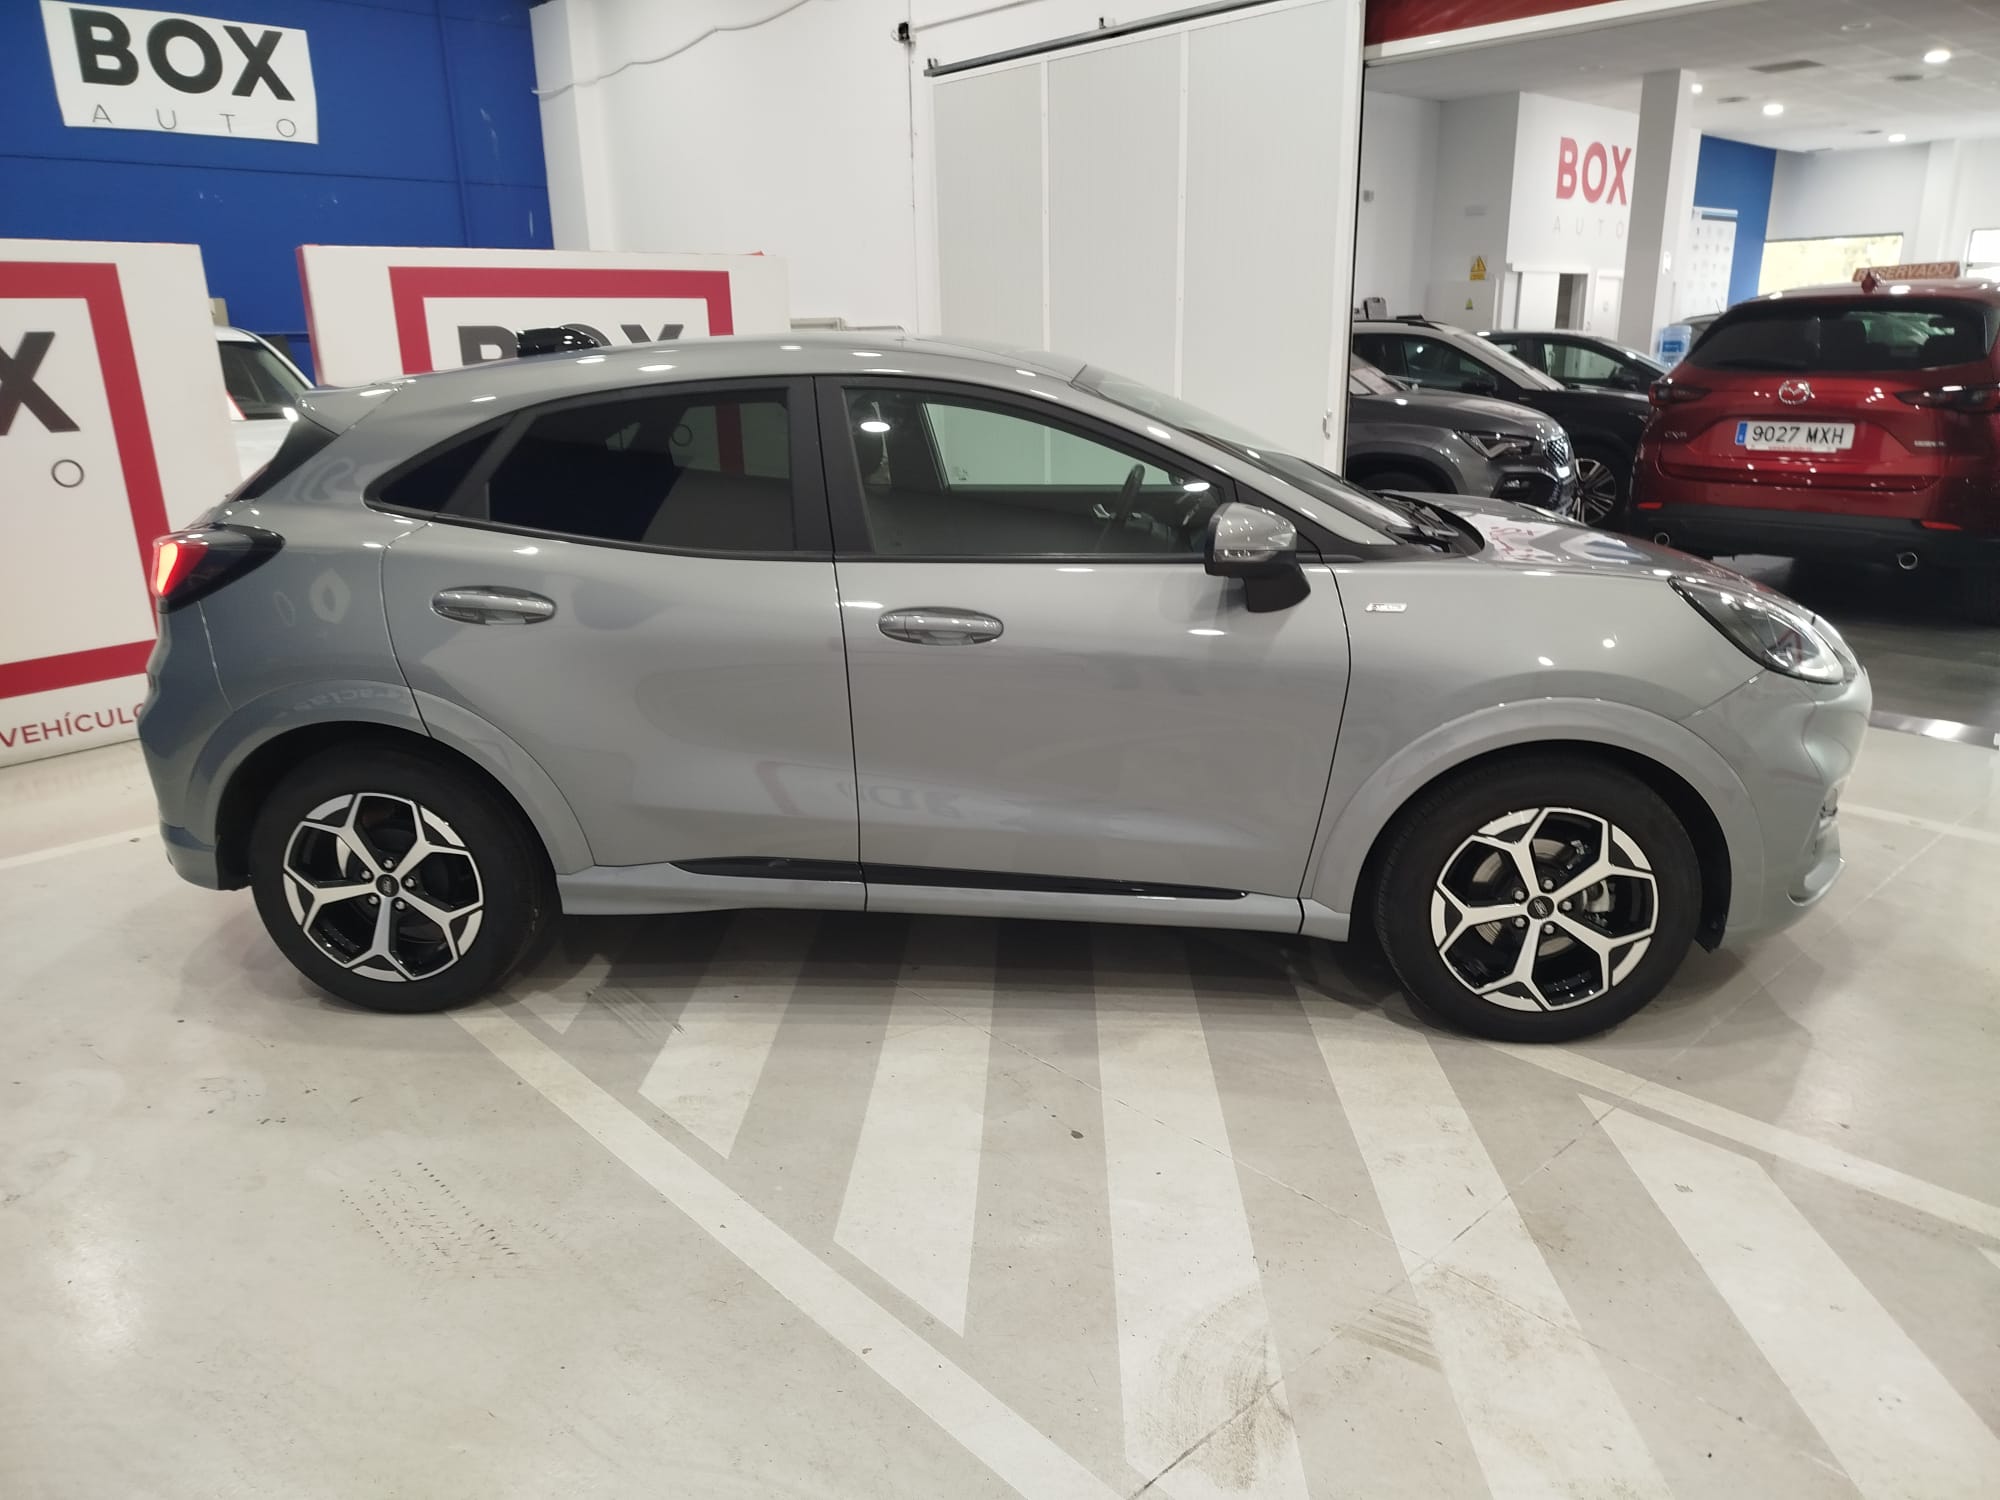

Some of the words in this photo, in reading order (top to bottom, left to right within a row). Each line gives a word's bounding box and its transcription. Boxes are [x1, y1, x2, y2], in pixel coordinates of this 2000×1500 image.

[69, 7, 296, 101] BOX
[92, 103, 297, 138] AUTO
[1556, 136, 1632, 206] BOX
[1553, 215, 1625, 239] AUTO
[1752, 426, 1800, 442] 9027
[1806, 426, 1844, 444] MXH
